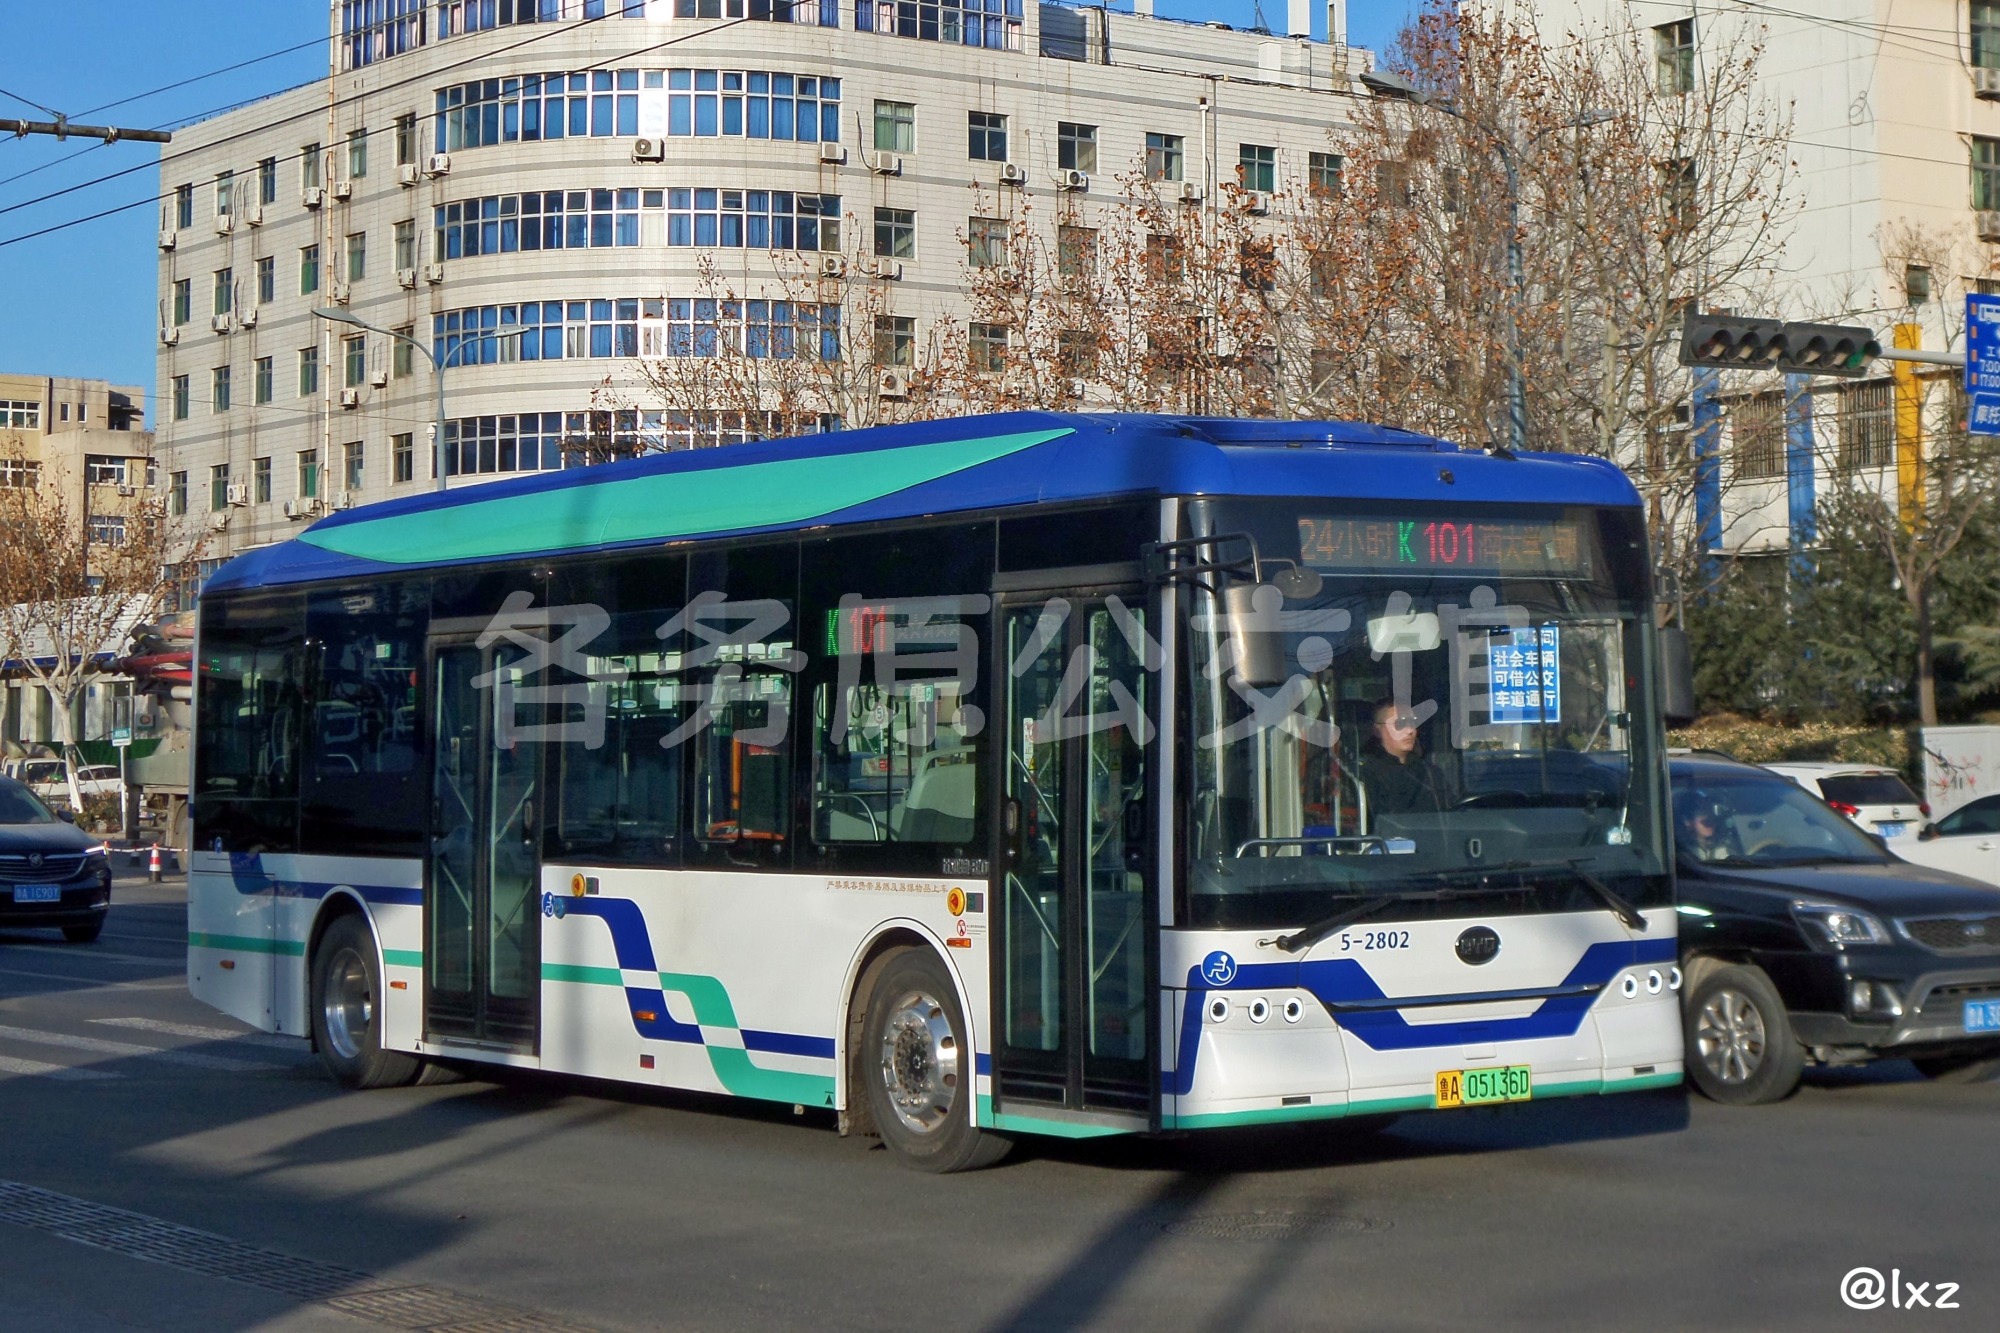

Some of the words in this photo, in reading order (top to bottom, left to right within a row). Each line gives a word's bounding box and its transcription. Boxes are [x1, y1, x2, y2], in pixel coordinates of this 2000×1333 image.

[1494, 670, 1555, 688] 可借公交
[1495, 690, 1556, 707] 车道通行
[1340, 930, 1410, 950] 5-2802
